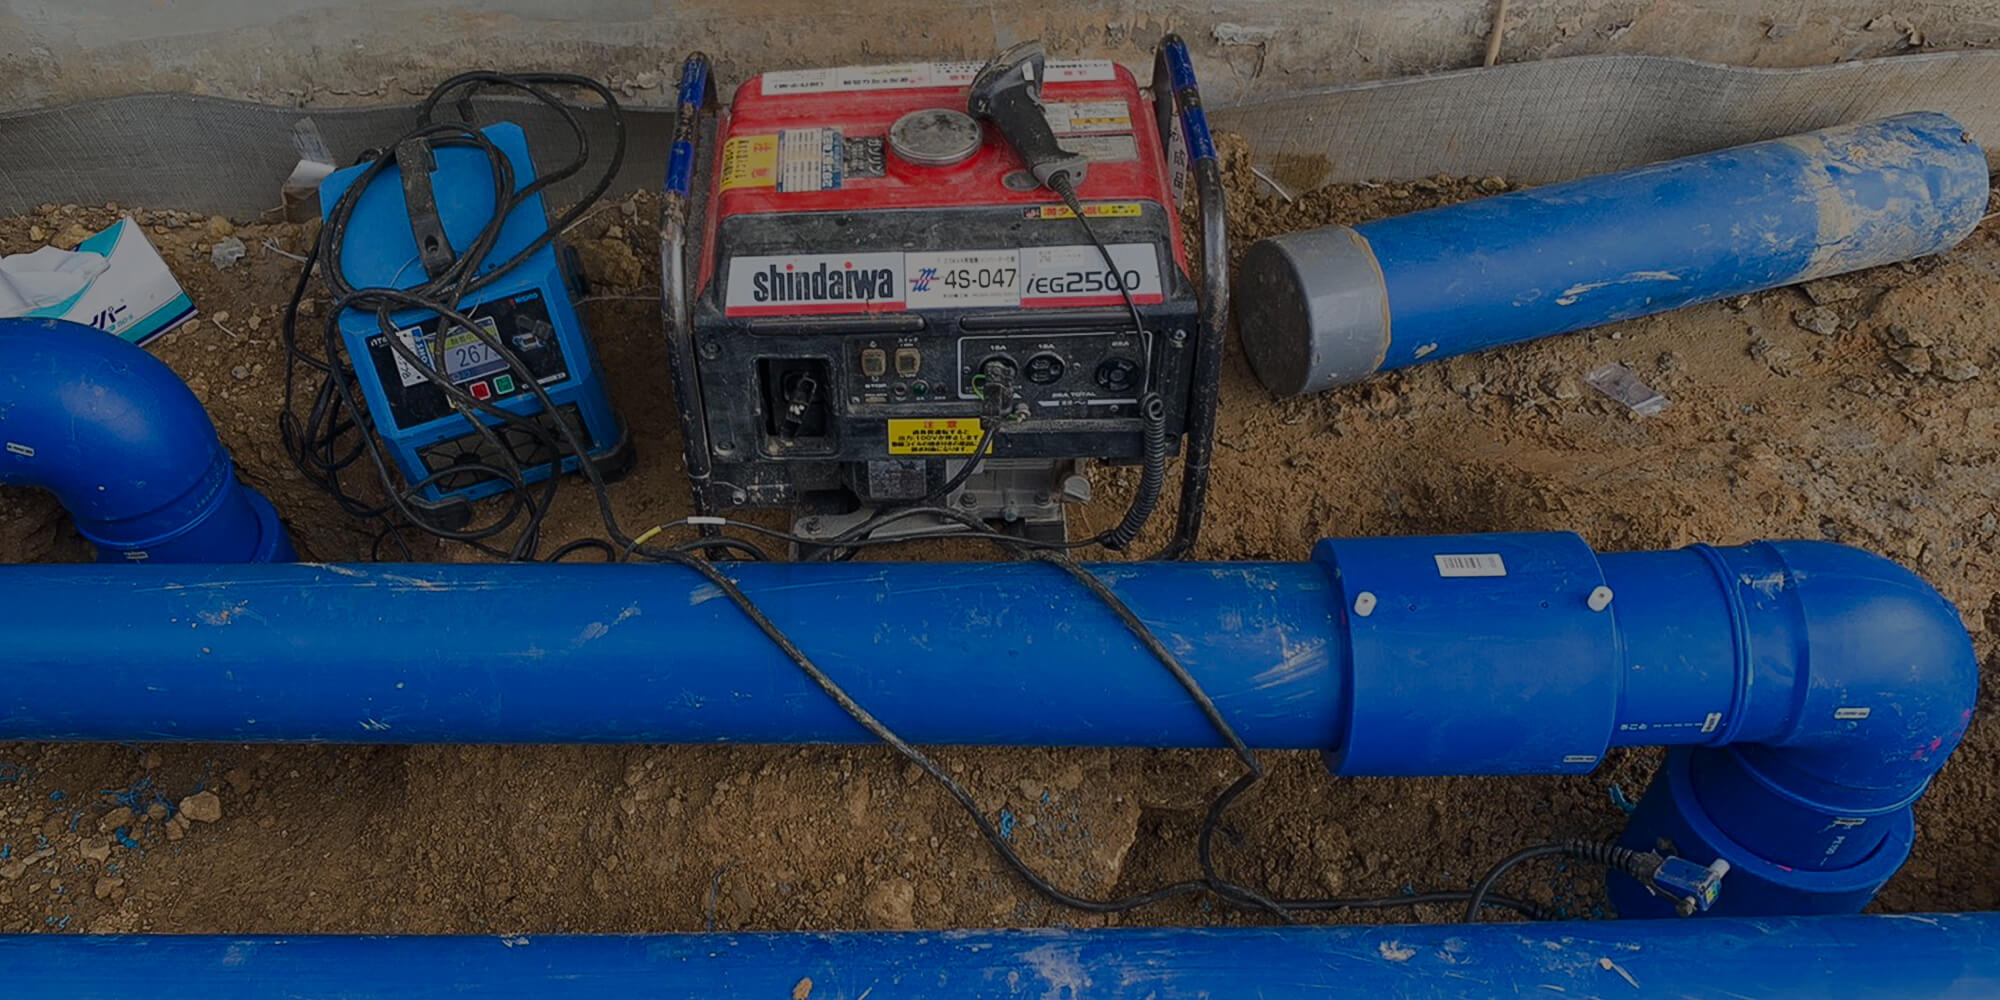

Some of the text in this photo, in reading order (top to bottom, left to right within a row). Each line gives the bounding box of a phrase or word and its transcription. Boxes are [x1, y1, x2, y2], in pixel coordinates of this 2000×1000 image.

[753, 261, 893, 301] shindaiwa
[944, 268, 1017, 289] 4S-047
[1026, 270, 1141, 294] iEG2500
